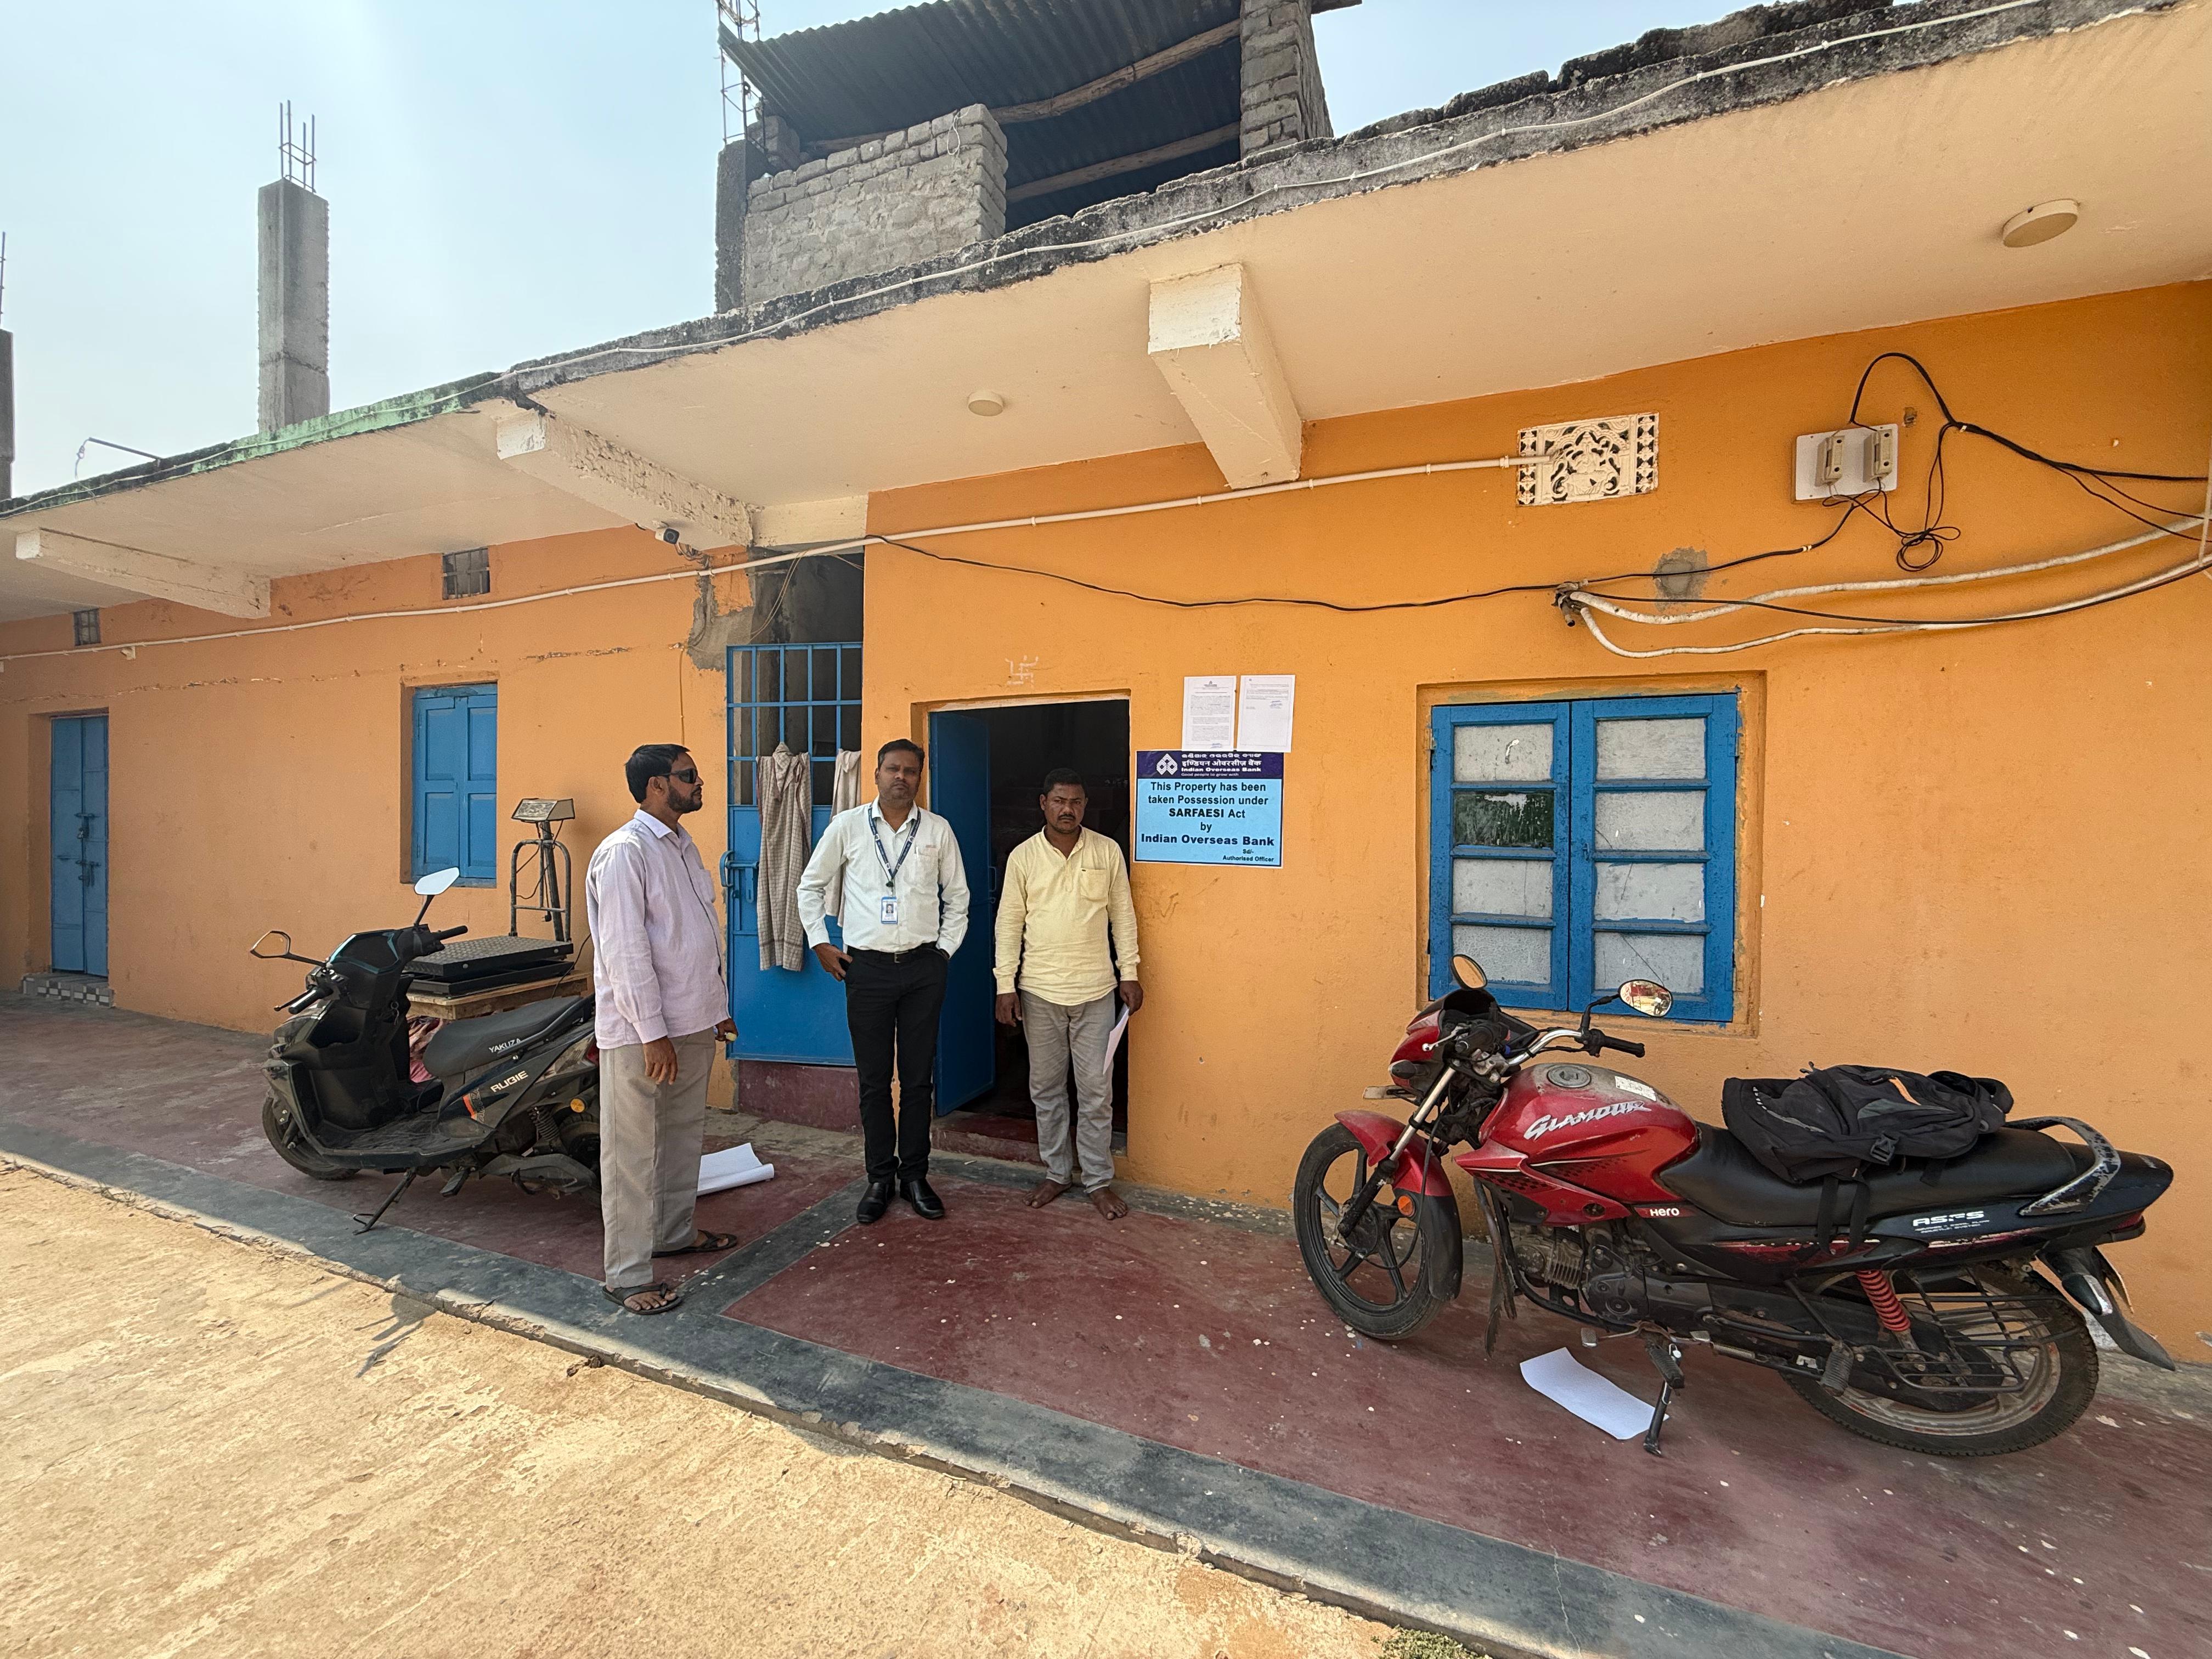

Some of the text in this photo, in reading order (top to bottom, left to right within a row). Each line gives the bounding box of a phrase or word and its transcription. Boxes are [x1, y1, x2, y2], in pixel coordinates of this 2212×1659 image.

[1151, 782, 1266, 793] This Property has been
[1148, 795, 1268, 805] taken Possession under
[1169, 808, 1245, 818] SARFAESI Act
[1200, 822, 1212, 833] by
[1141, 834, 1274, 846] Indian Overseas Bank
[488, 1038, 522, 1053] YAKUZA
[490, 1070, 529, 1092] RUBIE
